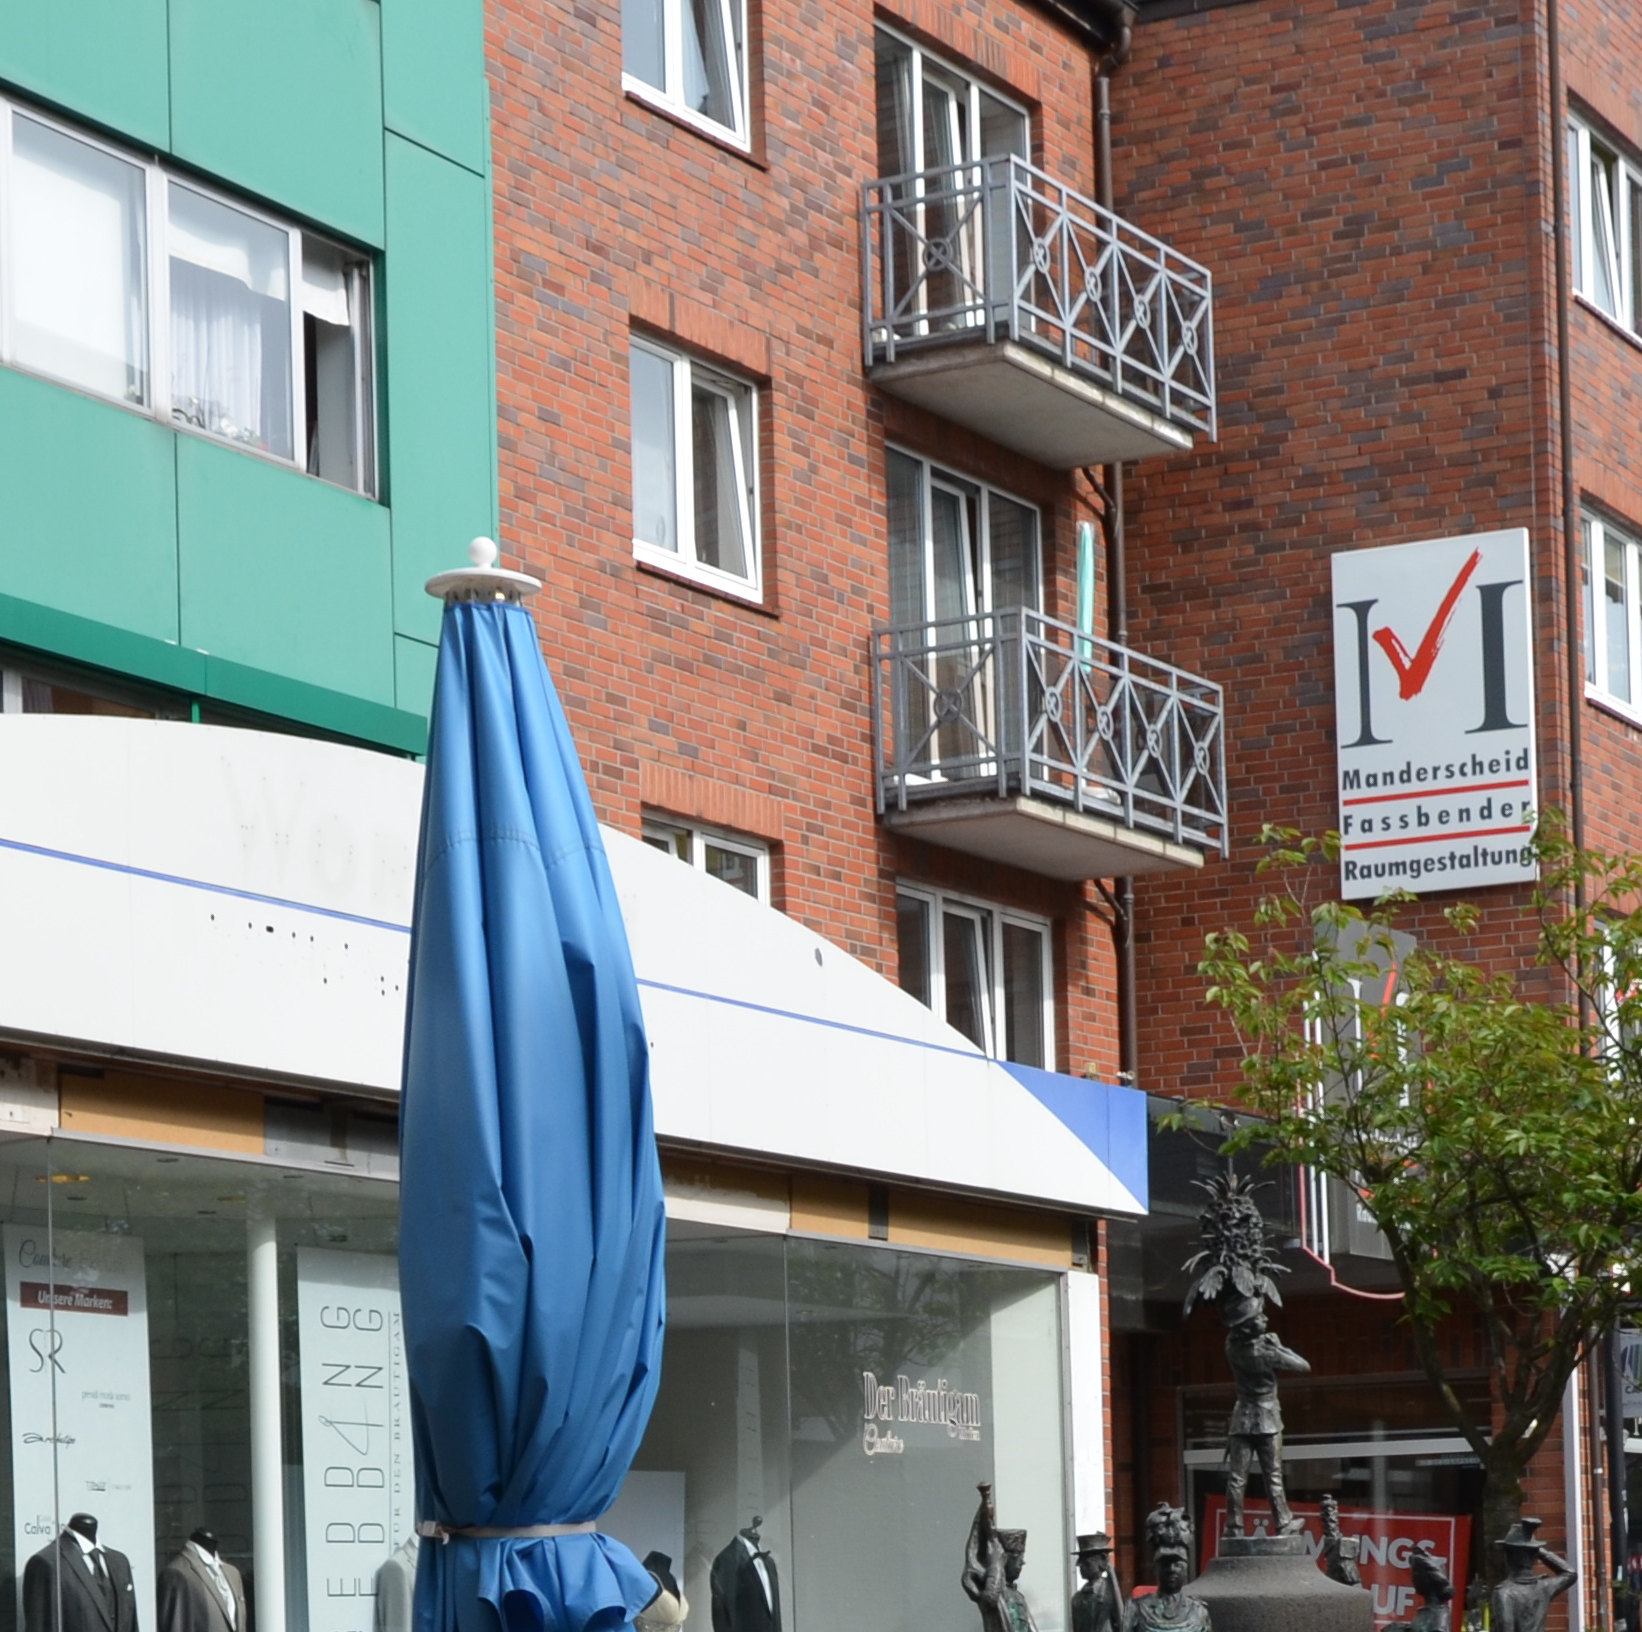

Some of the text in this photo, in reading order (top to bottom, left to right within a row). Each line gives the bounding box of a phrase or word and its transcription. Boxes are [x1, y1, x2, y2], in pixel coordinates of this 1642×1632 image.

[1342, 748, 1530, 791] Manderscheid
[1343, 797, 1531, 835] Fassbender
[1344, 845, 1534, 882] Raumgestaltung
[38, 1290, 114, 1310] Unsere Marken:
[863, 1371, 981, 1438] Der Bräutigam
